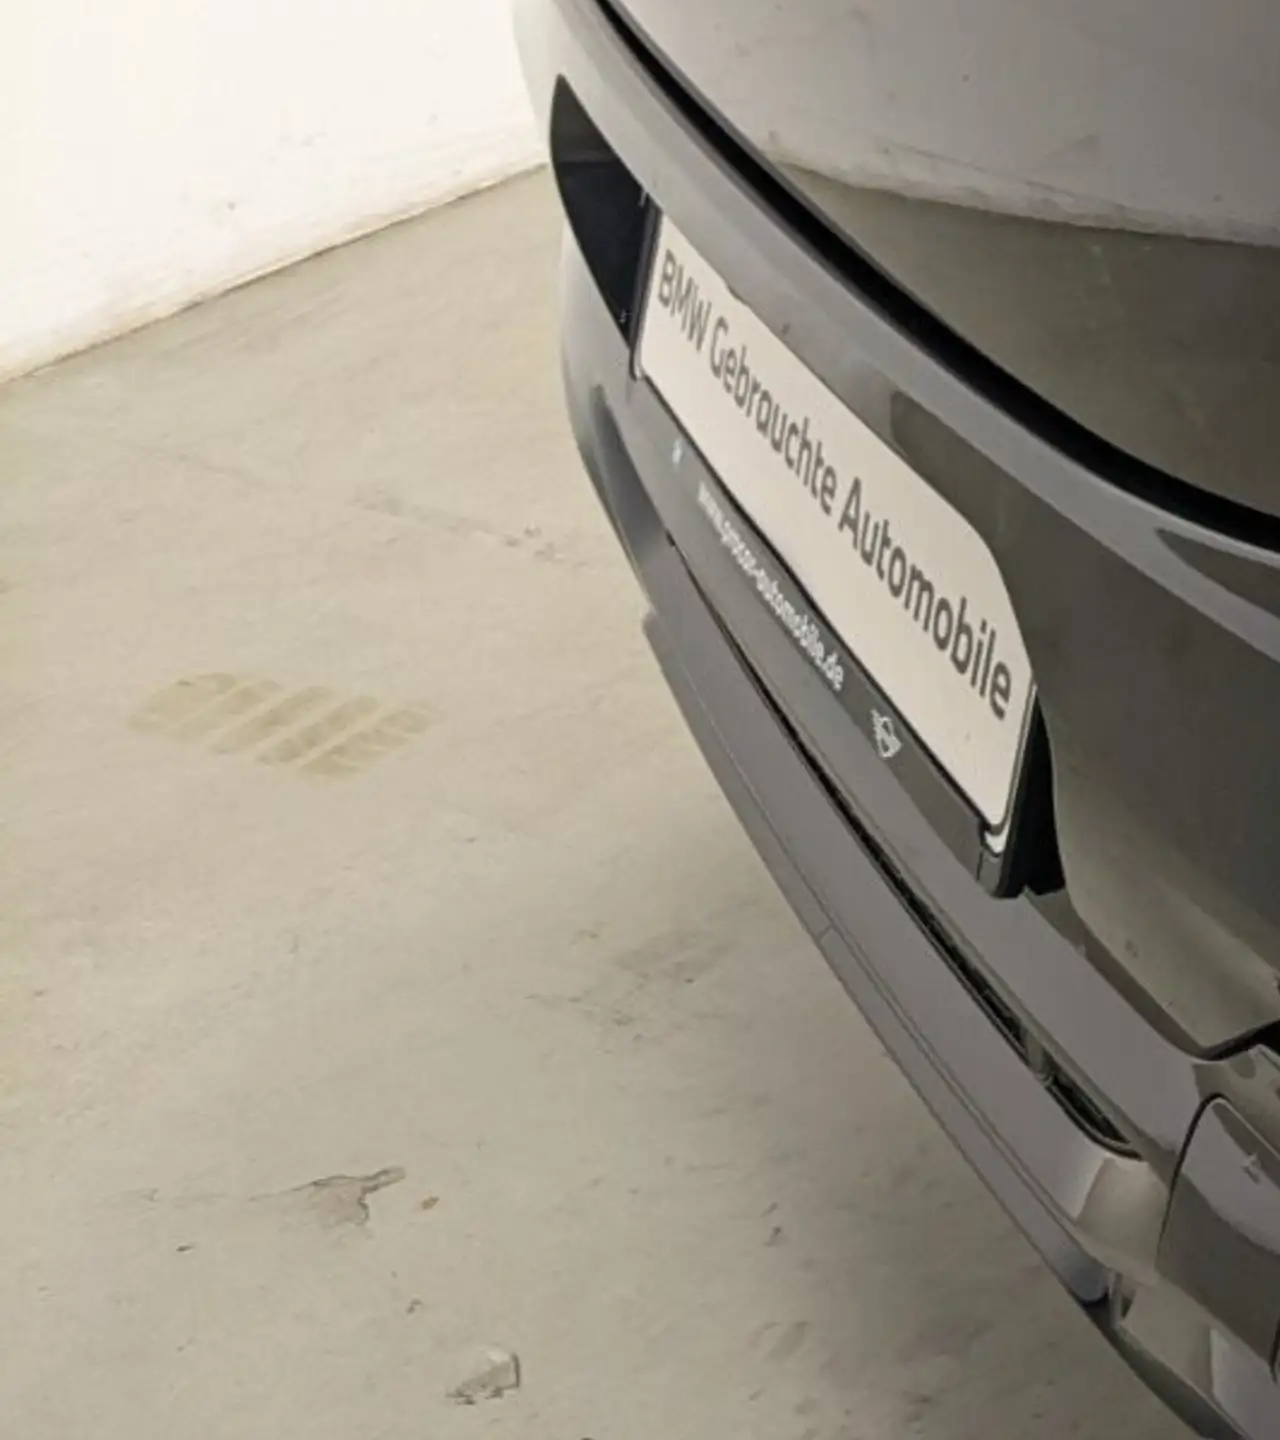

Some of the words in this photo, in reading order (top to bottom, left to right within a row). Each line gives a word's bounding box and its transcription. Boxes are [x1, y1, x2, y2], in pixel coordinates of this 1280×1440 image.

[657, 248, 713, 353] BMW
[709, 315, 838, 517] Gebrauchte
[837, 477, 1013, 721] Automobile
